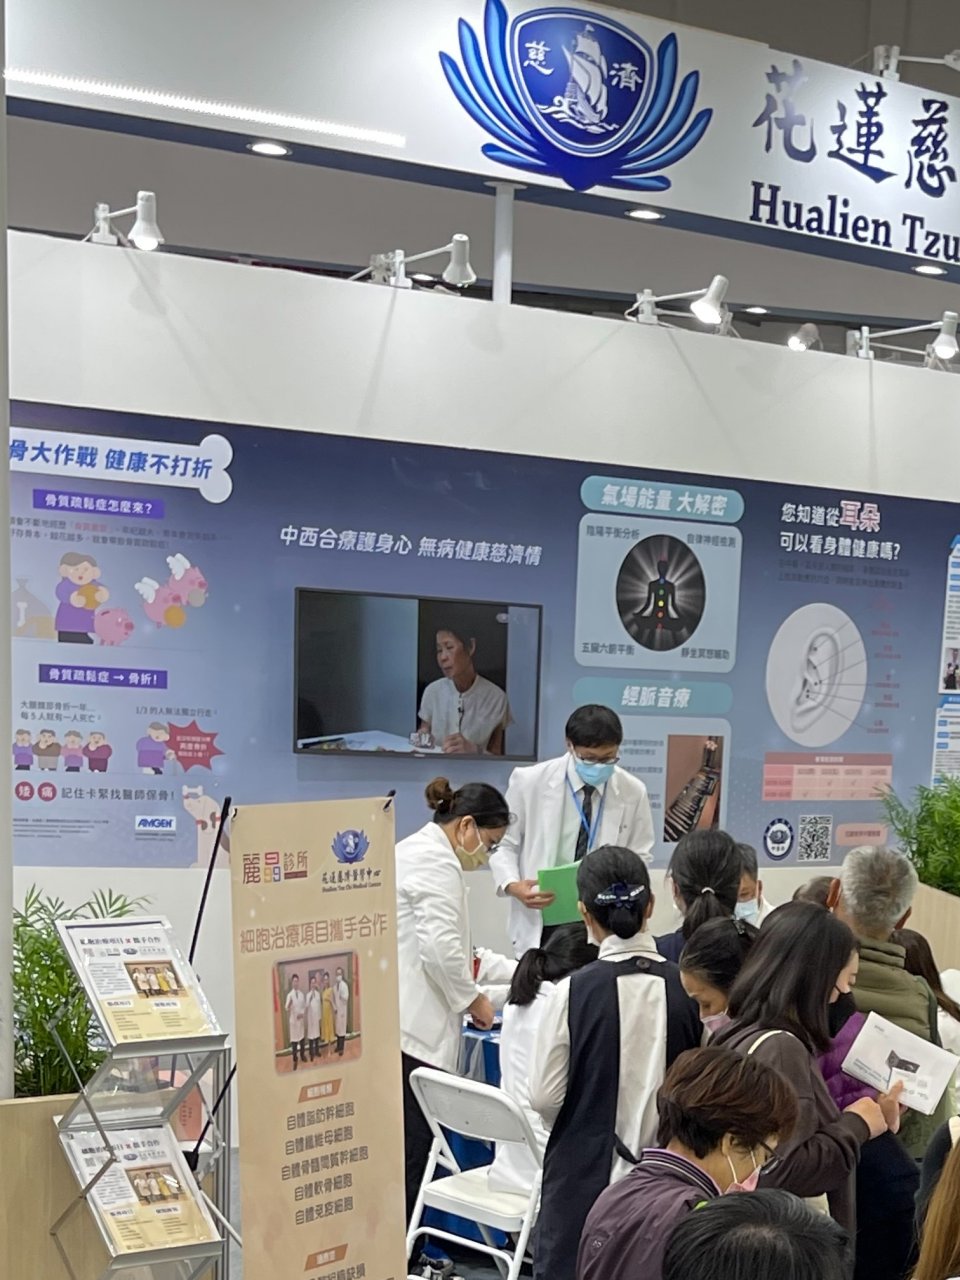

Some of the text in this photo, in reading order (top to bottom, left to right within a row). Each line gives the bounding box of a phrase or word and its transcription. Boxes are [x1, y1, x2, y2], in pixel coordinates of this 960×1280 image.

[523, 40, 644, 92] 慈 濟
[749, 181, 893, 248] Hualien
[901, 213, 960, 262] Tzu
[105, 448, 213, 479] 健康不打折
[601, 484, 728, 516] 氣場能量 大解密
[781, 500, 881, 532] 您知道從耳朵
[280, 525, 543, 566] 中西合療護身心 無病健康慈濟情
[780, 531, 901, 561] 可以看身體健康嗎?
[49, 668, 158, 685] 骨質疏鬆症 骨折!
[138, 818, 173, 828] AMGEN
[240, 913, 388, 954] 細胞治療項目攜手合作
[287, 1101, 355, 1131] 自體脂肪幹細胞
[285, 1126, 354, 1156] 自體纖維母細胞
[294, 1173, 353, 1201] 自體軟骨細胞
[295, 1196, 354, 1225] 自體免疫細胞
